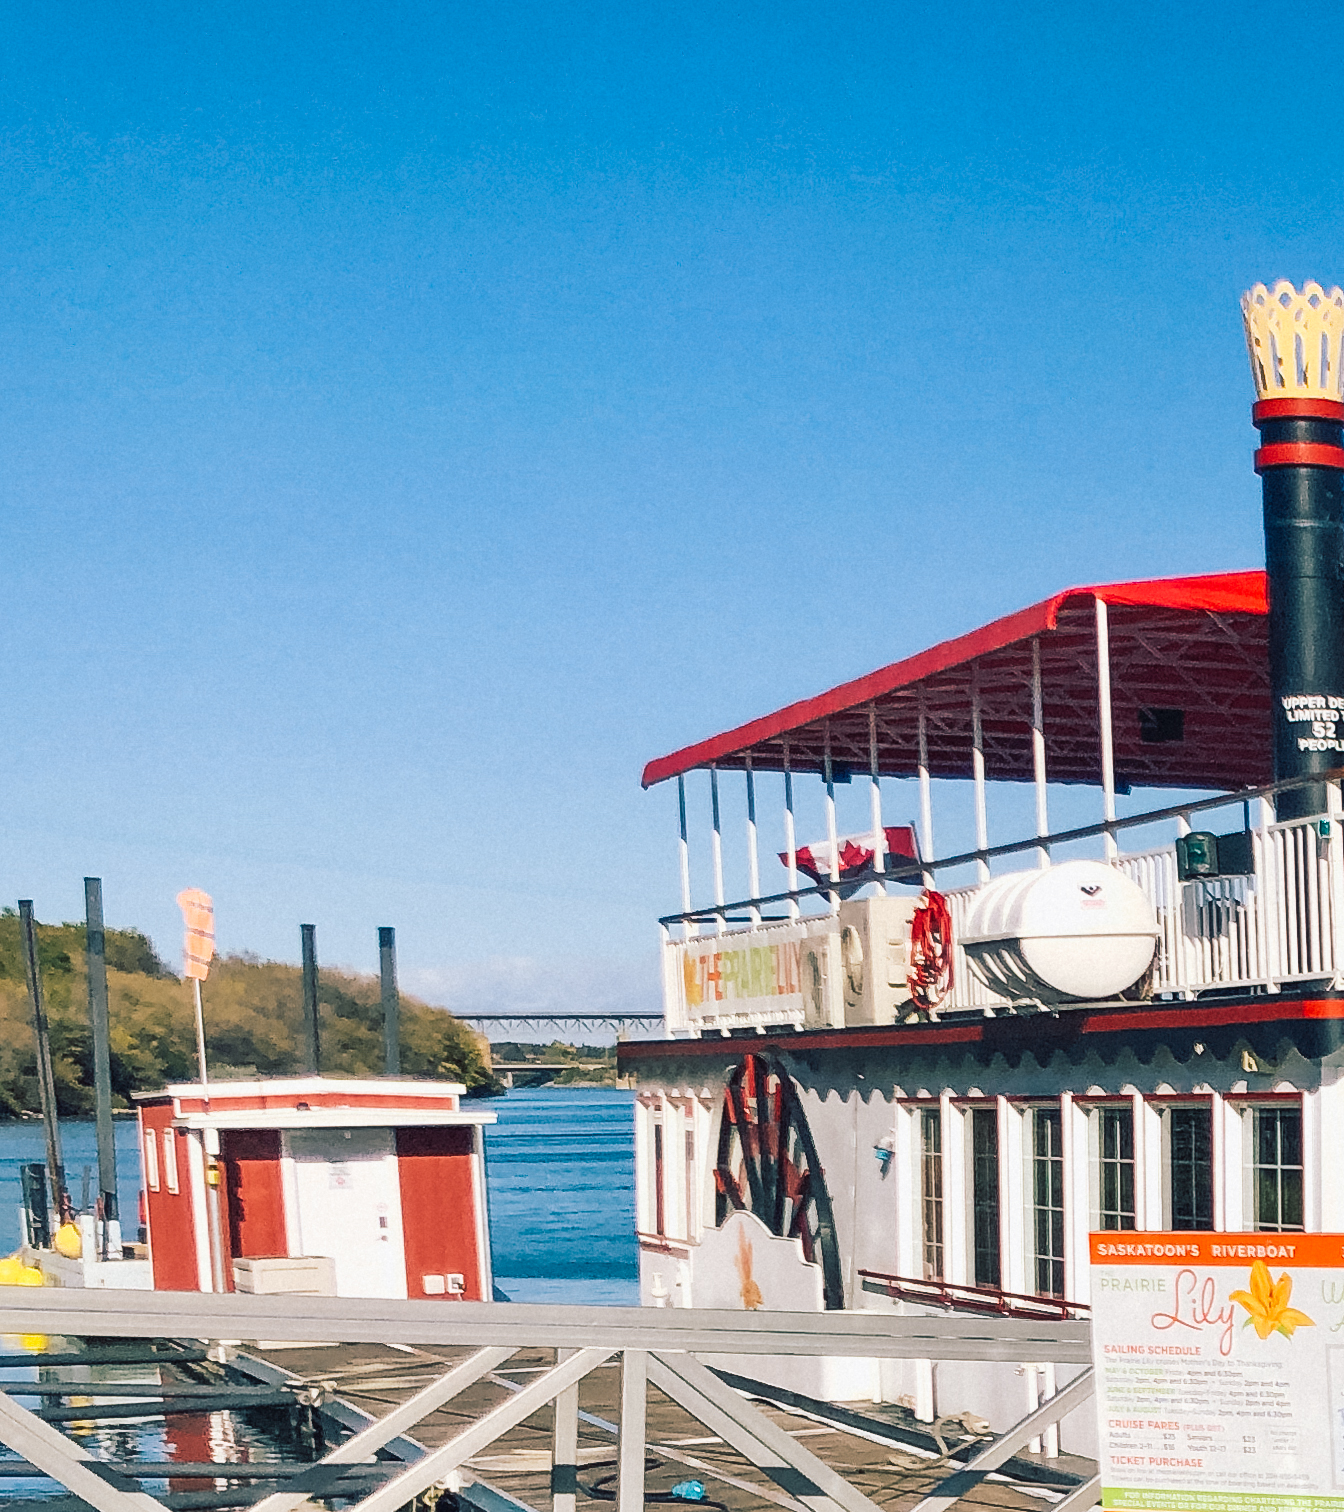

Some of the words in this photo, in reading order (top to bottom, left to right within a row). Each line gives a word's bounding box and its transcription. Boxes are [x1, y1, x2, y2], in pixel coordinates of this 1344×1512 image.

[1281, 694, 1326, 710] UPPER
[1286, 708, 1339, 722] LIMITED
[1312, 721, 1337, 738] 52
[1097, 1244, 1200, 1257] SASKATOON'S
[1211, 1244, 1296, 1258] RIVERBOAT
[1100, 1278, 1166, 1292] PRAIRIE
[1151, 1269, 1235, 1356] Lily
[1104, 1344, 1145, 1354] SAILING
[1147, 1346, 1202, 1355] SCHEDULE
[1108, 1420, 1144, 1429] CRUISE
[1147, 1421, 1180, 1430] FARES
[1110, 1455, 1146, 1465] TICKET
[1149, 1457, 1204, 1468] PURCHASE
[1113, 1499, 1145, 1507] SPECIAL
[1142, 1492, 1195, 1501] INFORMATION
